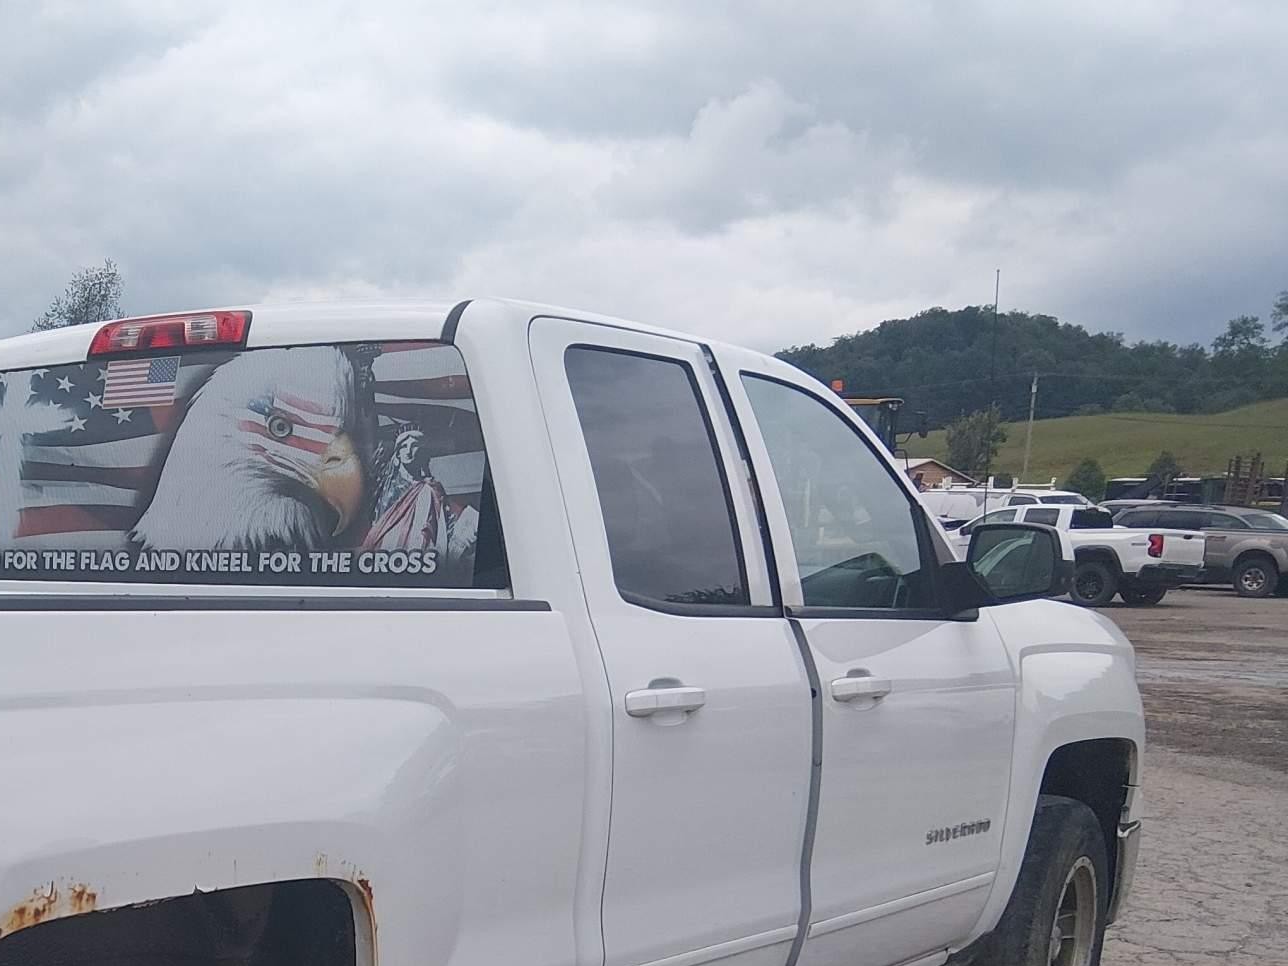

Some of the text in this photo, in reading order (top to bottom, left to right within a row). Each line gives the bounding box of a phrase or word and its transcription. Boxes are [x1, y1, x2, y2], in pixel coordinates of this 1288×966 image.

[4, 552, 38, 570] FOR
[42, 552, 75, 571] THE
[79, 552, 130, 571] FLAG
[135, 552, 180, 571] AND
[185, 552, 252, 572] KNEEL
[258, 552, 301, 572] FOR
[309, 552, 351, 573] THE
[358, 552, 437, 573] CROSS
